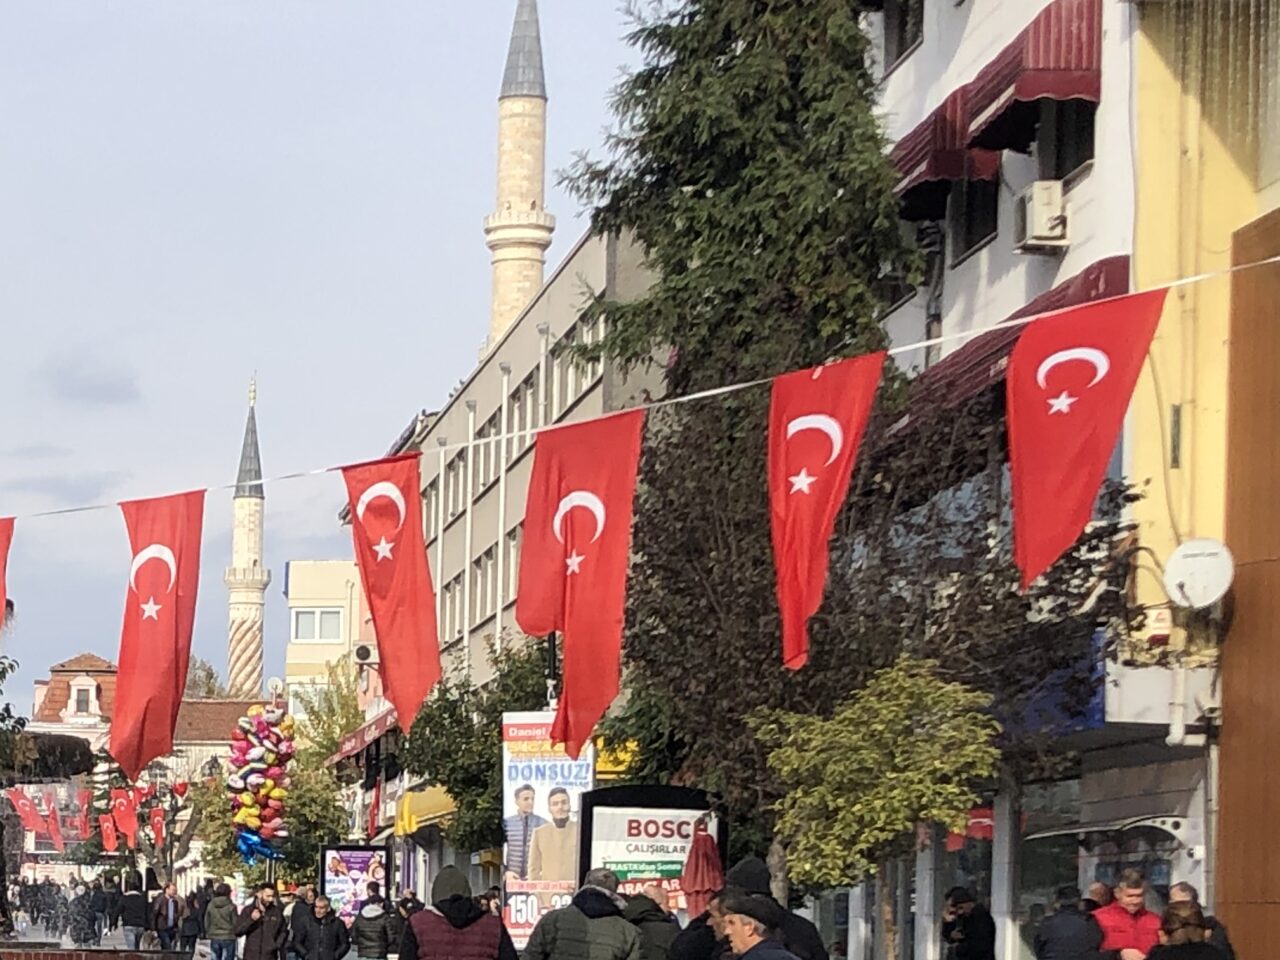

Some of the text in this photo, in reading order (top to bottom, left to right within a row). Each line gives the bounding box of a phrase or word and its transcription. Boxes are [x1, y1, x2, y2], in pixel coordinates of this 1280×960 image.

[507, 763, 590, 781] DONSUZ!
[625, 843, 687, 855] ÇALIŞIRLAR
[507, 894, 538, 924] 150
